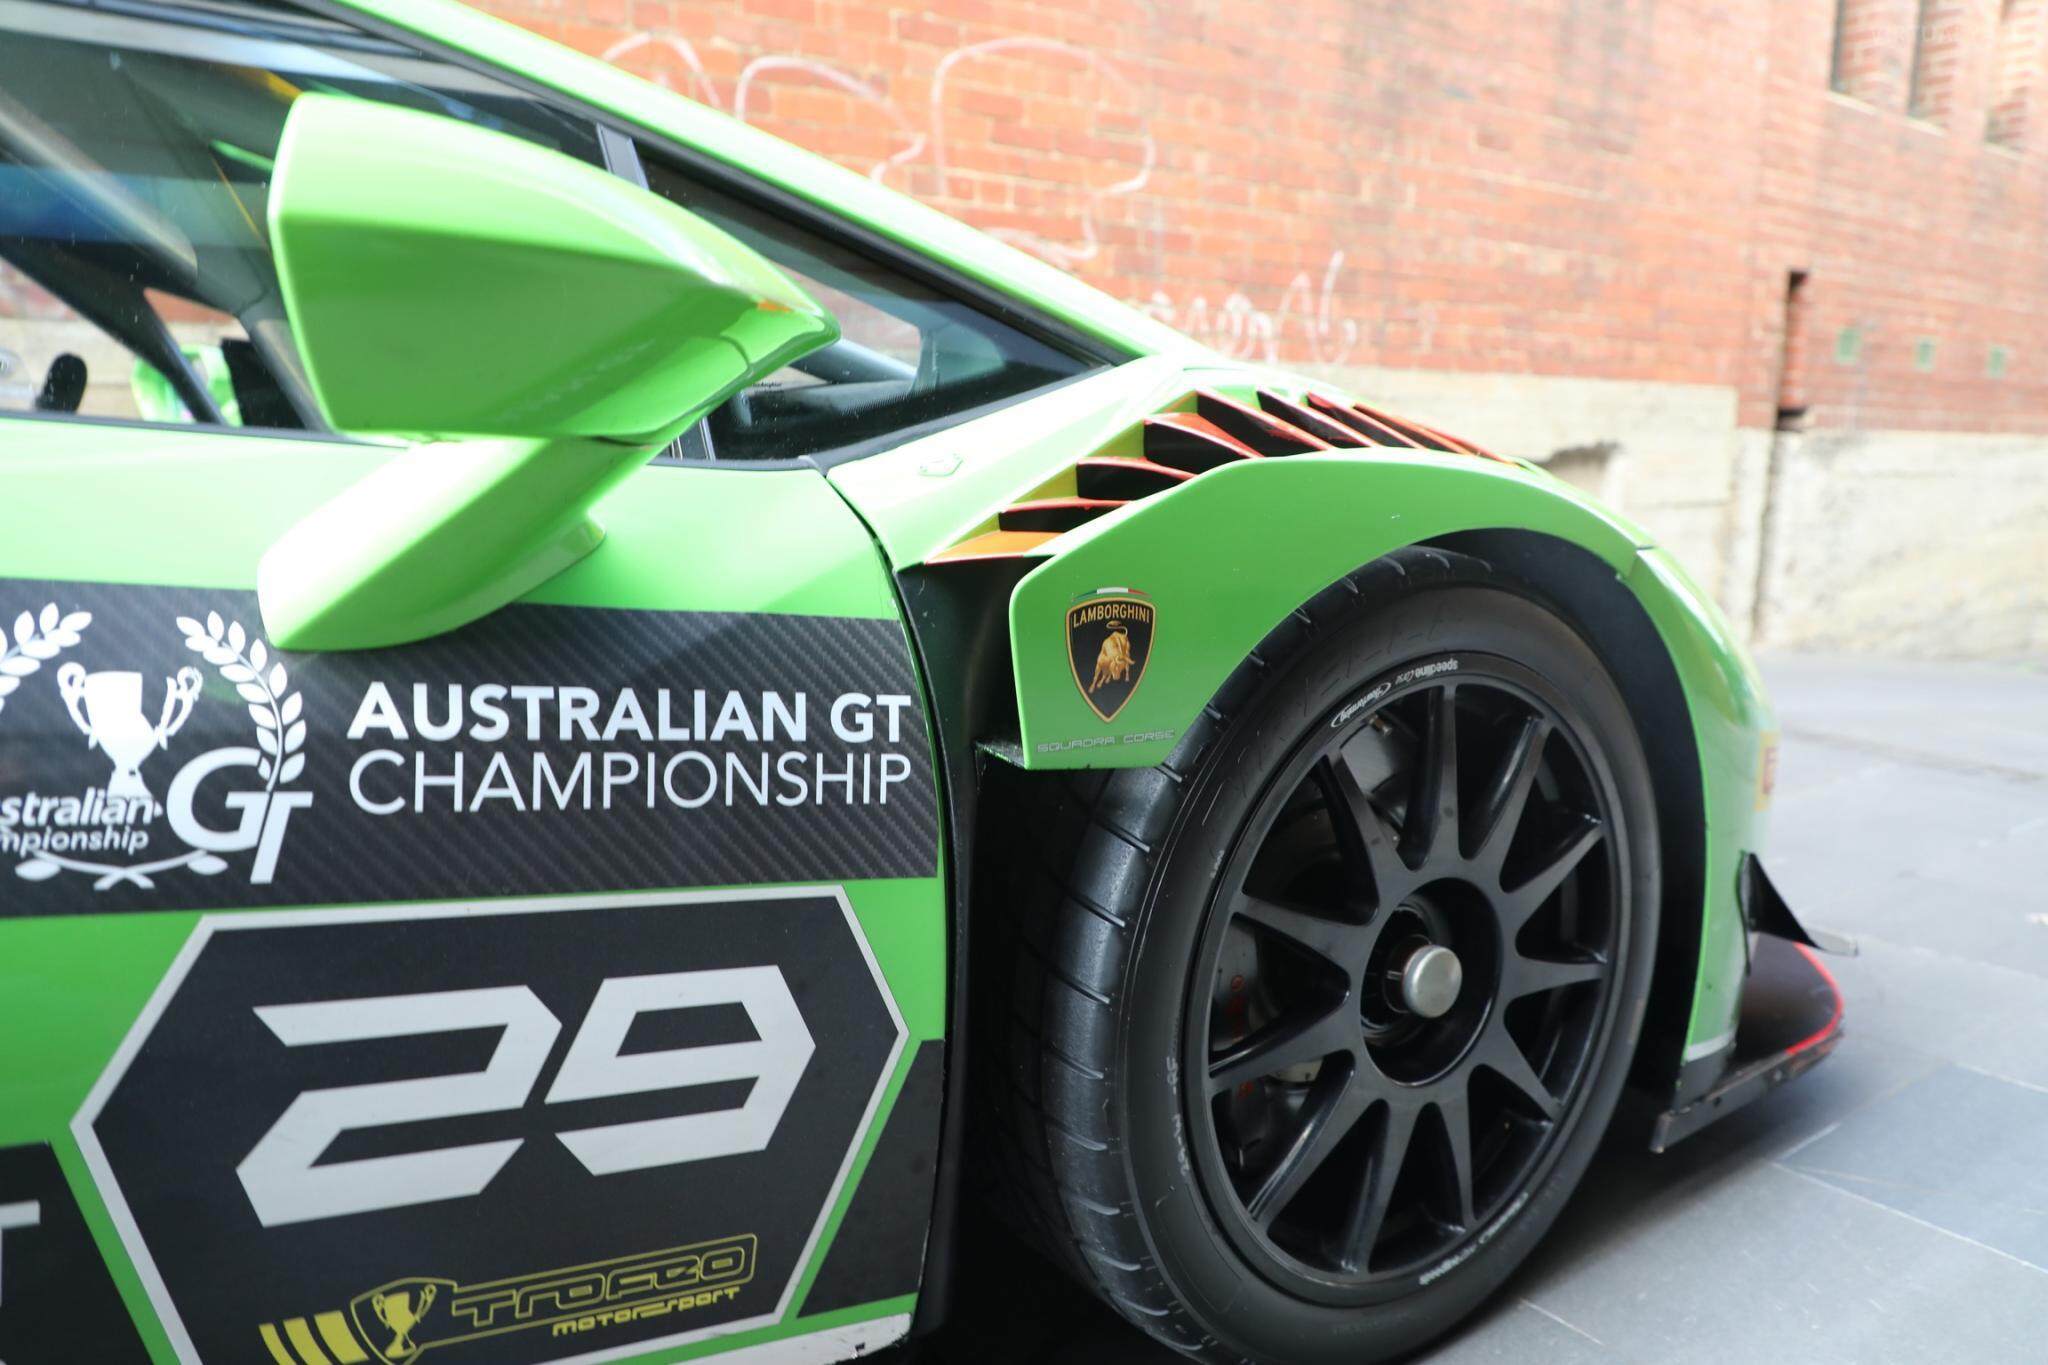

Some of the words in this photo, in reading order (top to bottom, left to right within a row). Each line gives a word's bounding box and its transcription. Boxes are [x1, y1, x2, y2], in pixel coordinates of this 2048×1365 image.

[1073, 603, 1151, 628] LAMBORGHINI
[346, 682, 806, 742] AUSTRALIAN
[829, 694, 911, 744] GT
[1037, 736, 1115, 752] SQUADRA
[1123, 729, 1175, 744] CORSE
[348, 748, 912, 816] CHAMPIONSHIP
[167, 747, 313, 885] GT
[236, 965, 816, 1228] 29
